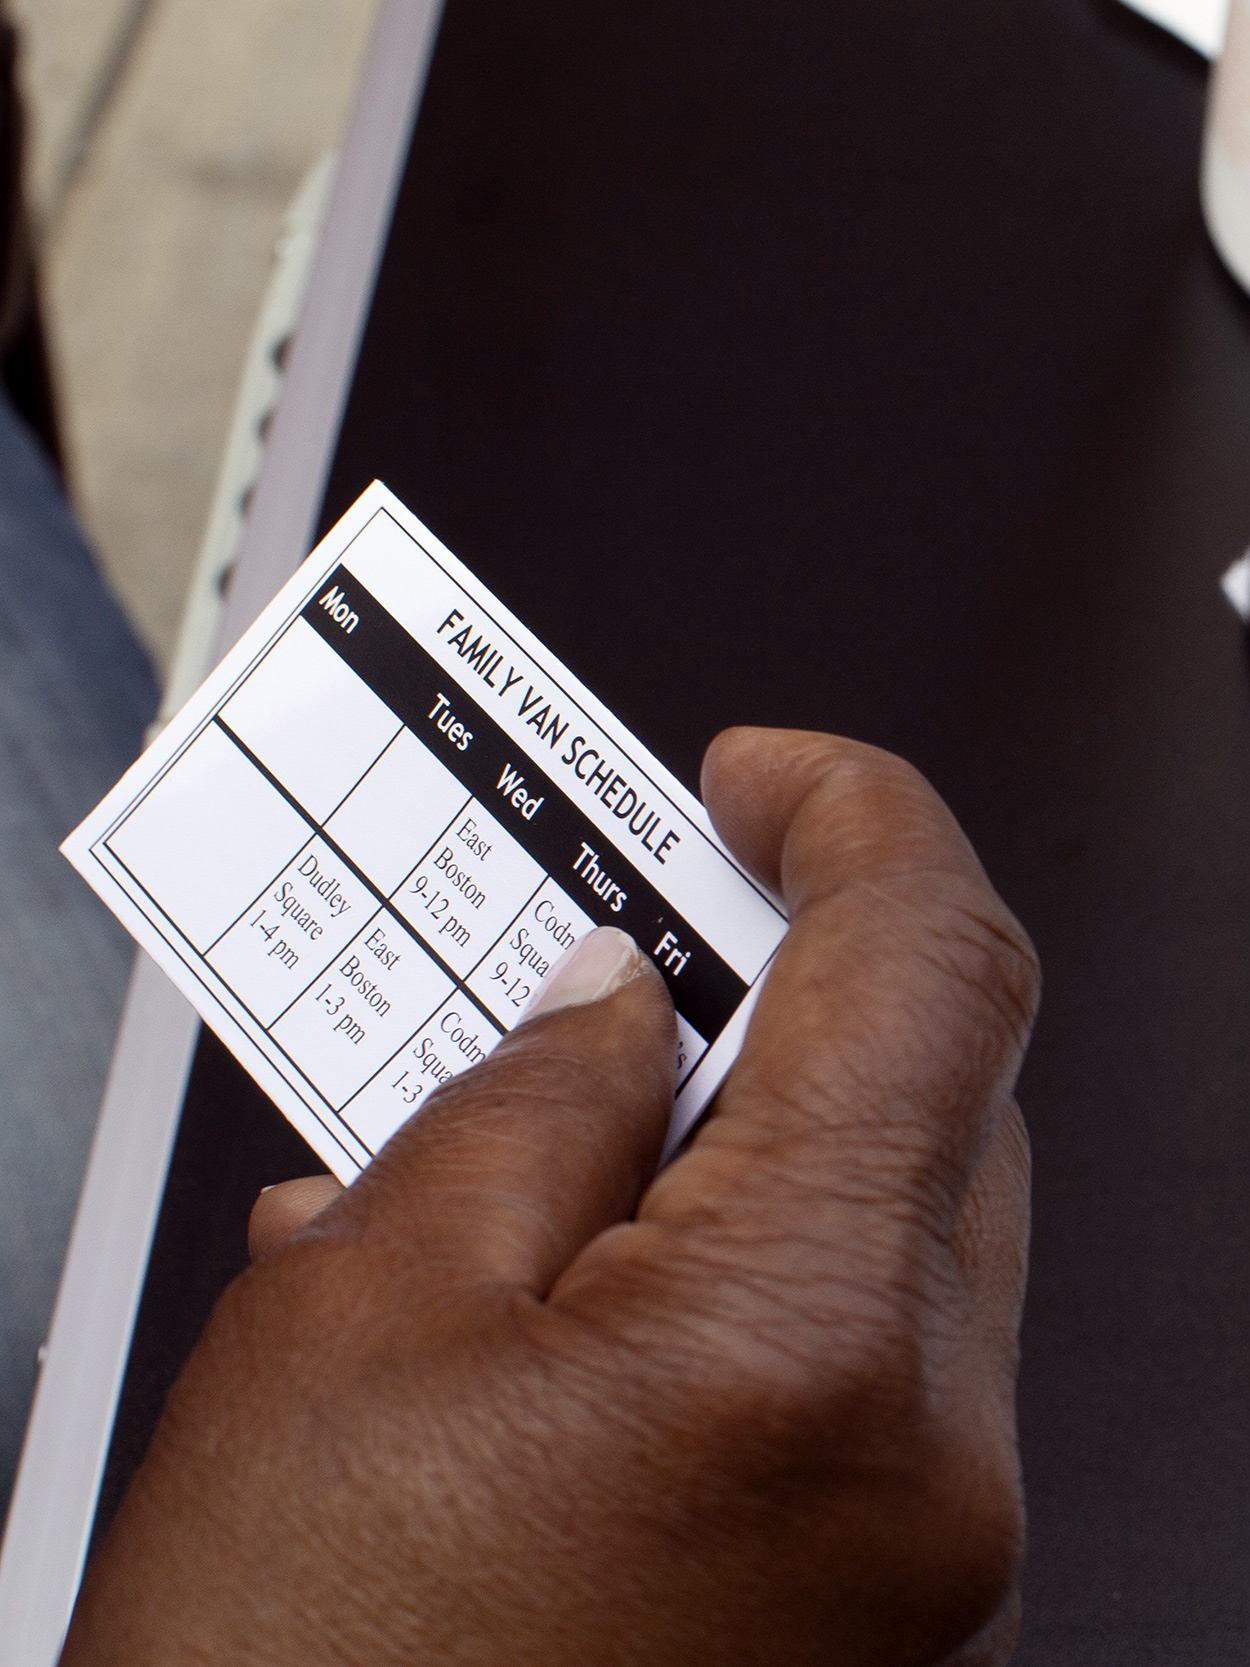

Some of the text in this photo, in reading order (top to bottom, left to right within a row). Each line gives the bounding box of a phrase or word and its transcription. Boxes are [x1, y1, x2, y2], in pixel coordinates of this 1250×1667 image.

[436, 608, 682, 866] FAMILY VAN SCHEDULE
[318, 585, 691, 976] Mon Tues Wed Thurs Fri
[455, 817, 493, 861] East
[297, 853, 352, 918] Dudley
[433, 846, 486, 910] Boston
[249, 909, 300, 971] 1-4 pm
[273, 881, 324, 941] Square
[409, 875, 472, 948] 9-12 pm
[363, 927, 401, 971] East
[509, 928, 550, 978] Squa
[314, 982, 366, 1046] 1-3 pm
[339, 955, 392, 1018] Boston
[489, 961, 531, 1007] 9-12
[412, 1037, 454, 1084] Squa
[440, 1011, 487, 1064] Codm
[390, 1070, 424, 1104] 1-3
